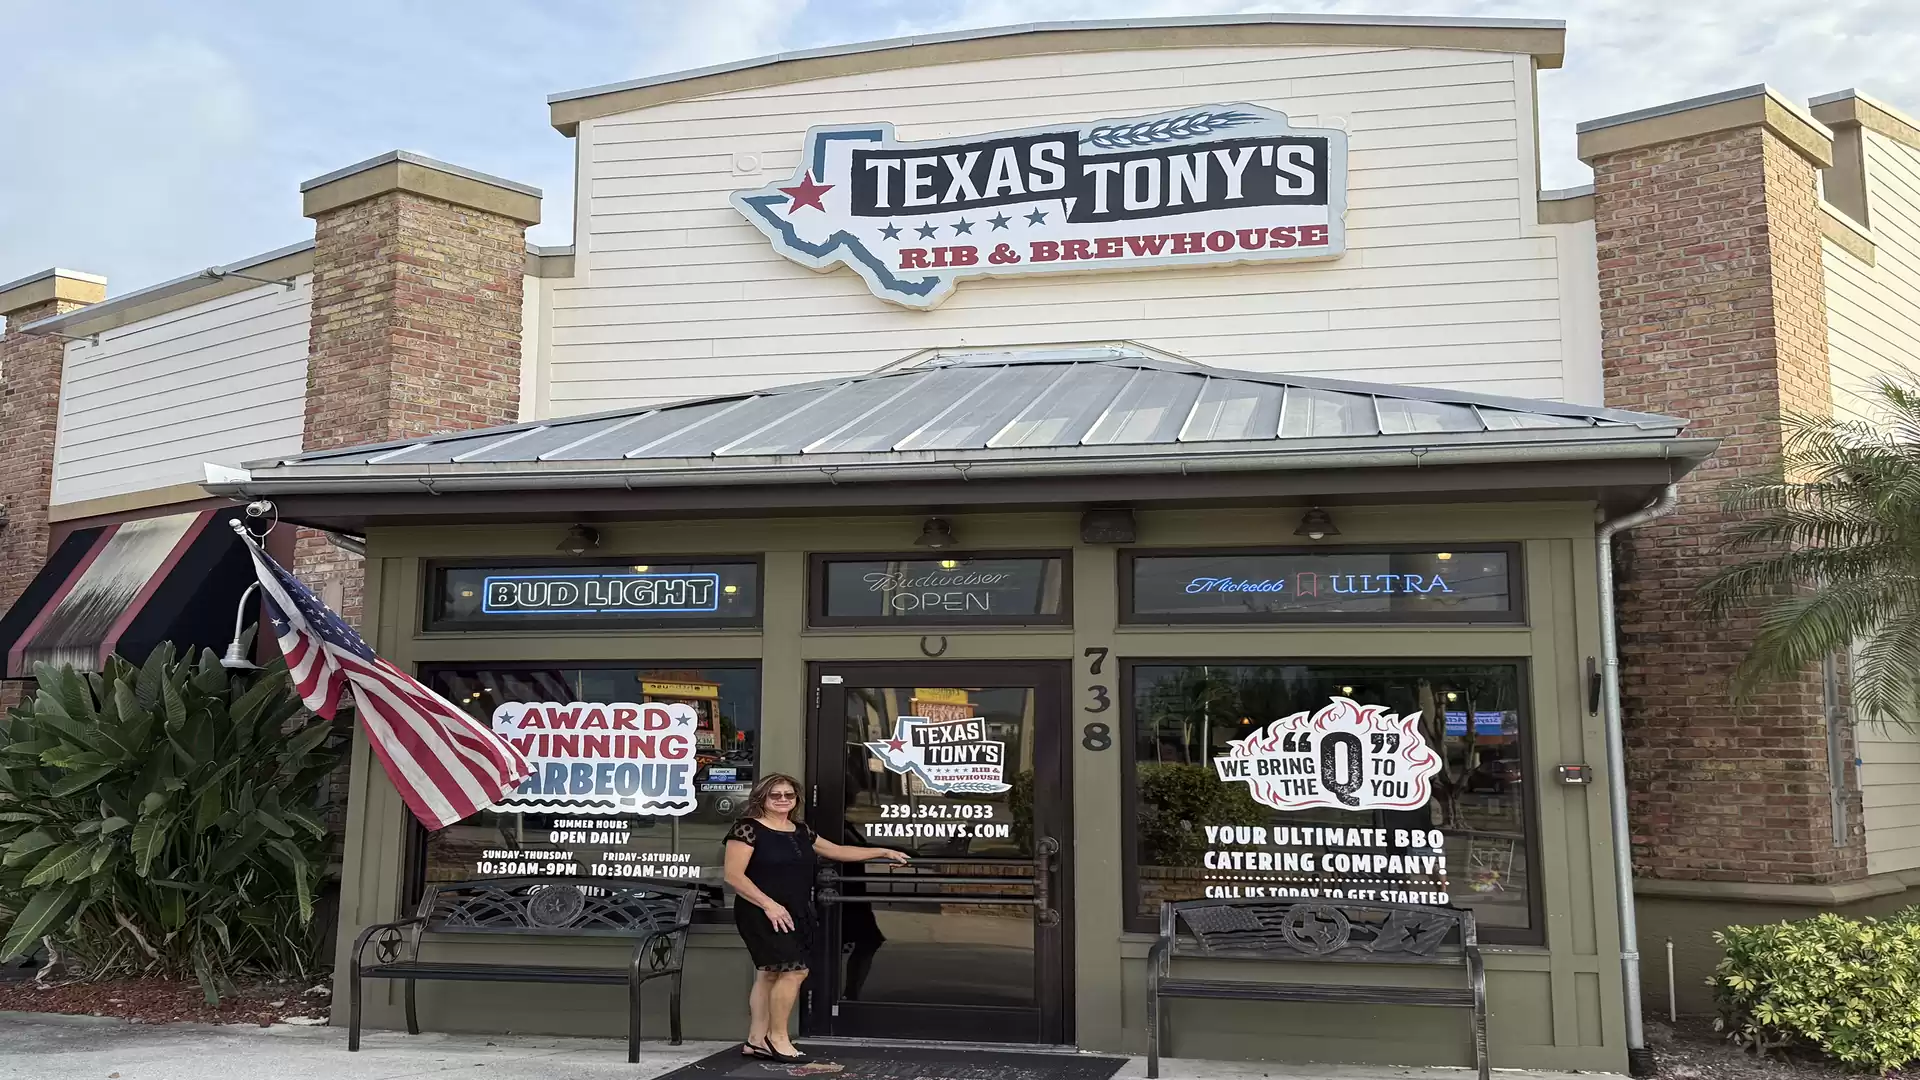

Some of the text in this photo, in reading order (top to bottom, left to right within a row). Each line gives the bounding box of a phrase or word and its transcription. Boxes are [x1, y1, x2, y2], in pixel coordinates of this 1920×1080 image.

[864, 140, 1316, 214] TEXAS TONY'S
[900, 225, 1329, 269] RIB & BREWHOUSE
[862, 571, 1012, 592] Budweiser
[1185, 574, 1454, 594] Michelob ULTRA
[488, 579, 714, 607] BUD LIGHT
[891, 592, 990, 611] OPEN
[517, 707, 672, 731] AWARD
[914, 721, 980, 745] TEXAS
[499, 734, 689, 760] WINNING
[928, 745, 999, 764] TONY'S
[971, 766, 991, 774] RIB
[1220, 757, 1315, 777] WE BRING
[1371, 758, 1396, 776] TO
[516, 762, 690, 798] ARBEQUE
[933, 774, 1001, 782] BREWHOUSE
[1280, 778, 1319, 796] THE
[1370, 779, 1410, 799] YOU
[880, 804, 994, 819] 239.347.7033
[553, 819, 629, 830] SUMMER HOURS
[864, 823, 1009, 838] TEXASTONYS.COM
[550, 831, 631, 845] OPEN DAILY
[1204, 825, 1445, 853] YOUR ULTIMATE BBQ
[482, 850, 573, 860] SUNDAY-THURSDAY
[603, 852, 691, 863] FRIDAY-SATURDAY
[1204, 851, 1448, 876] CATERING COMPANY!
[476, 861, 578, 876] 10:30AM-9PM
[591, 863, 701, 878] 10:30AM-10PM
[1205, 885, 1450, 905] CALL US TODAY TO GET STARTED
